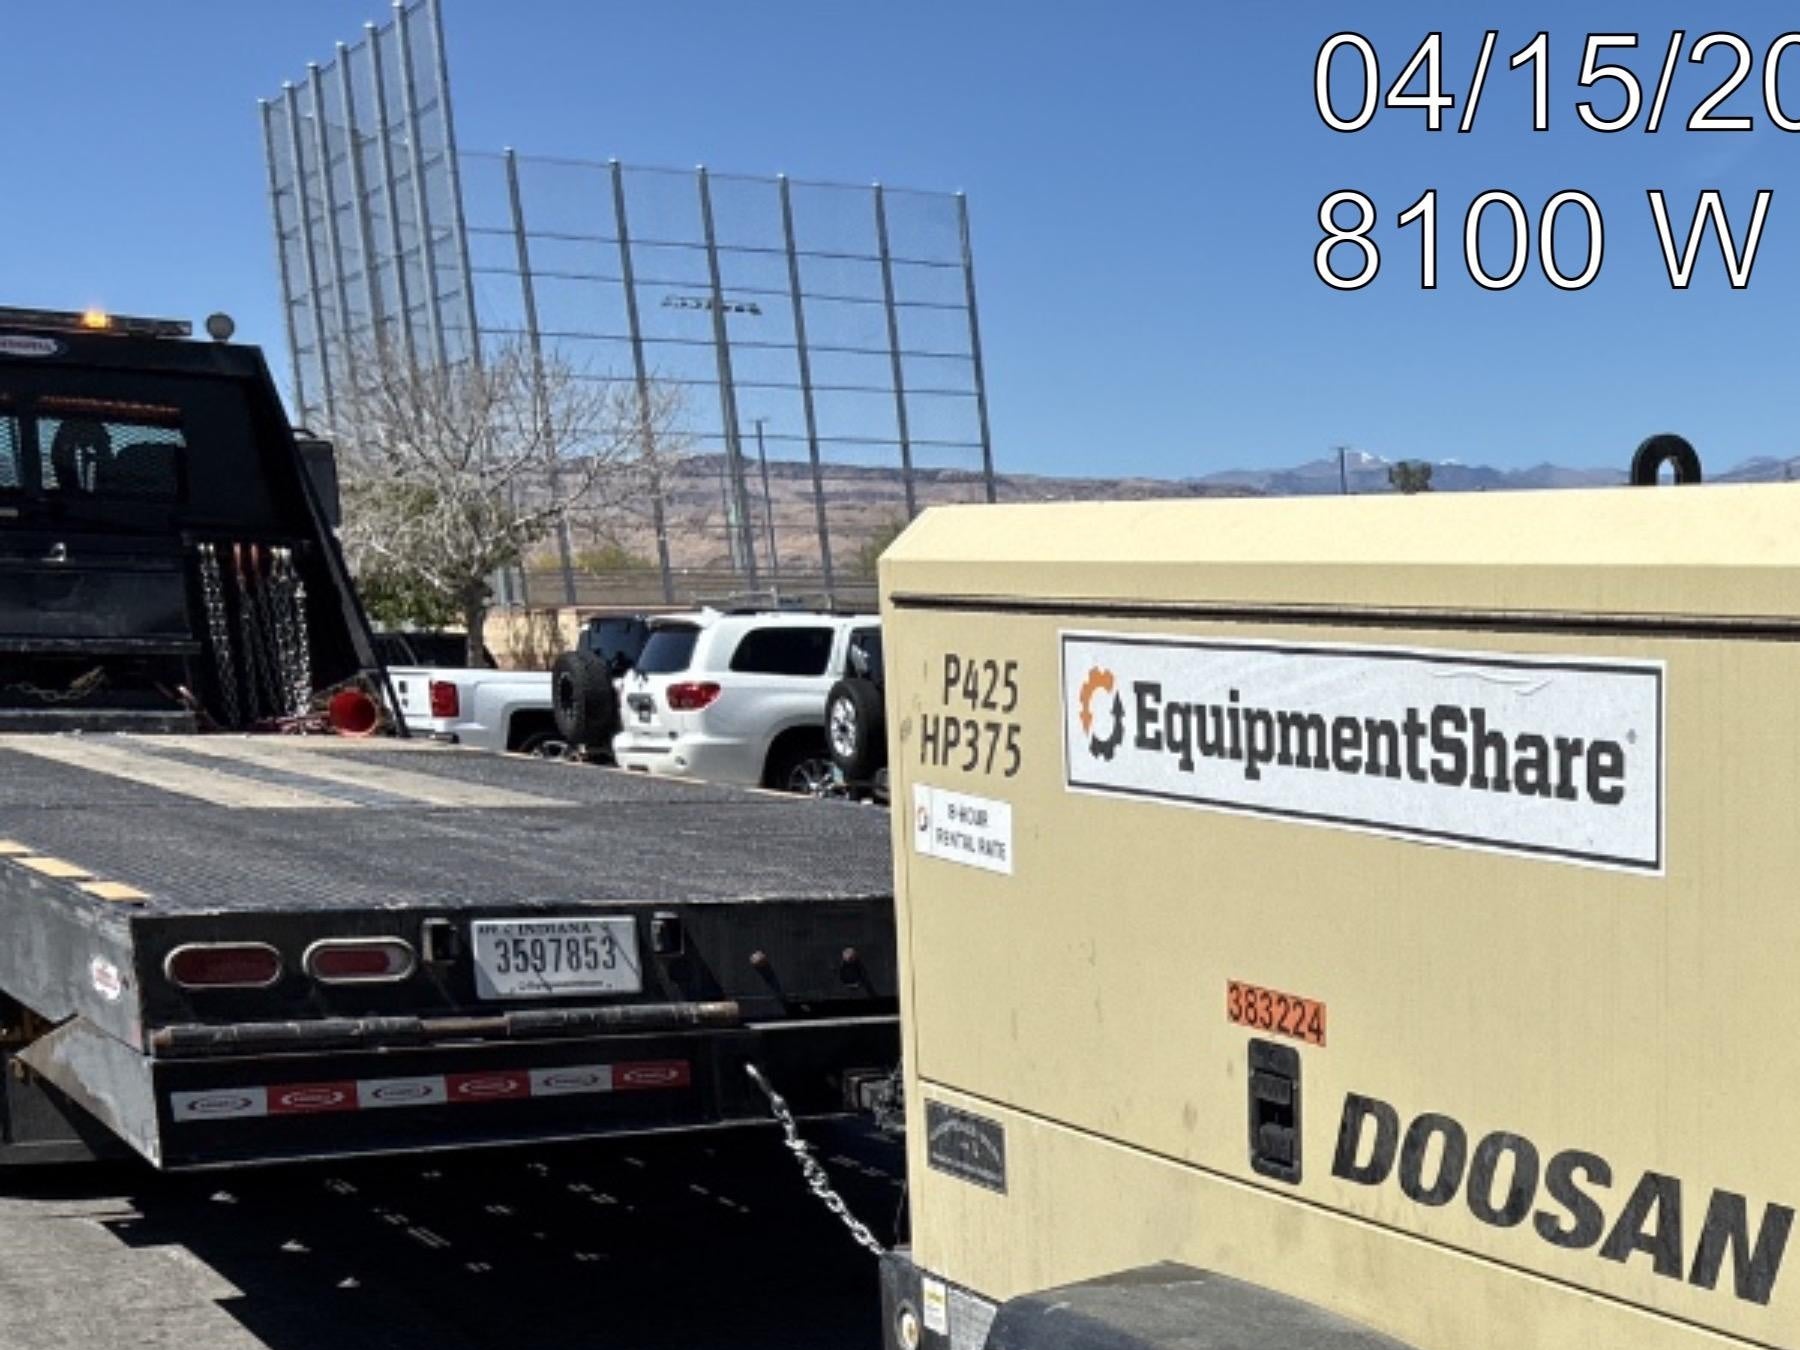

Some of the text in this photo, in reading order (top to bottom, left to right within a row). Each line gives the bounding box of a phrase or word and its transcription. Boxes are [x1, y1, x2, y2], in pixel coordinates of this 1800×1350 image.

[943, 653, 1018, 714] P425
[920, 713, 1021, 778] HP375
[1133, 680, 1626, 806] EquipmentShare
[494, 936, 617, 974] 3597853
[1228, 984, 1324, 1044] 383224
[1331, 1091, 1796, 1306] DOOSAN
